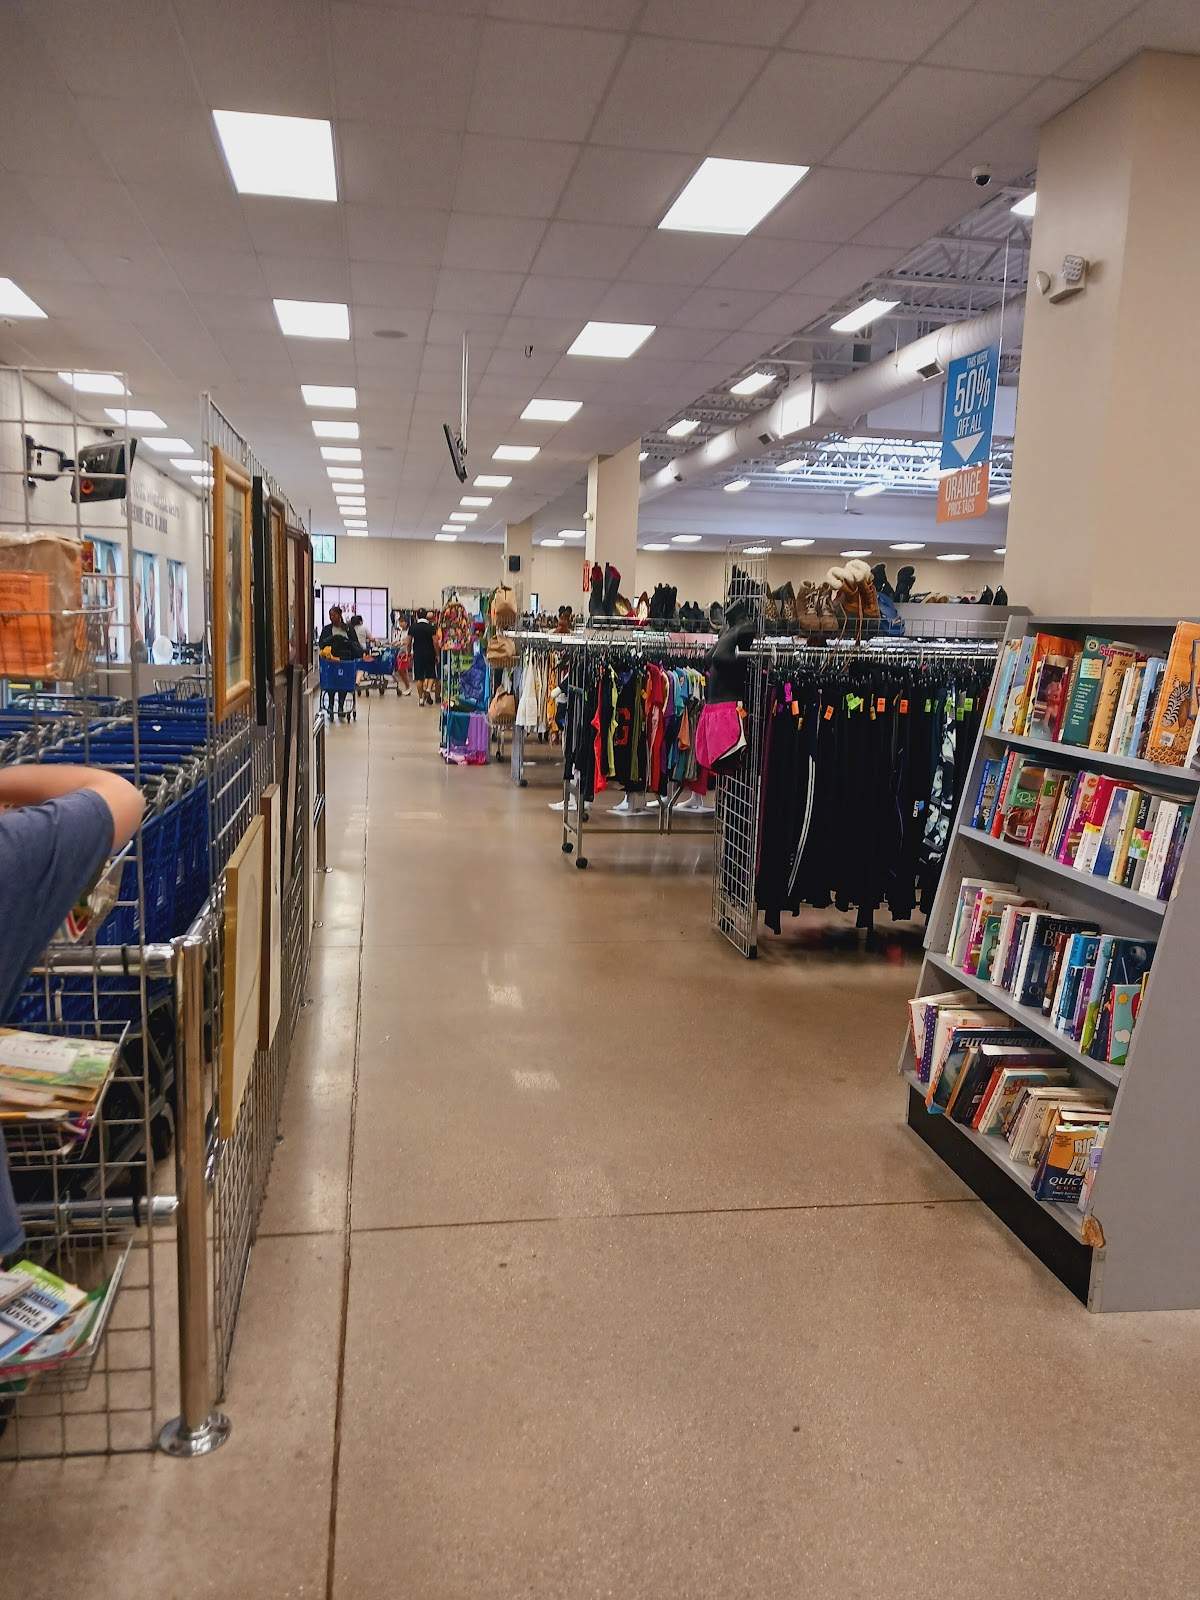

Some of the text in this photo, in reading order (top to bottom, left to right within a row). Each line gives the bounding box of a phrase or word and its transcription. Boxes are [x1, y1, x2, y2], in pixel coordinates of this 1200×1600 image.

[954, 362, 991, 418] 50%
[957, 412, 982, 438] OFF ALL
[945, 470, 982, 502] ORANGE
[947, 497, 975, 517] PRICE TAGS
